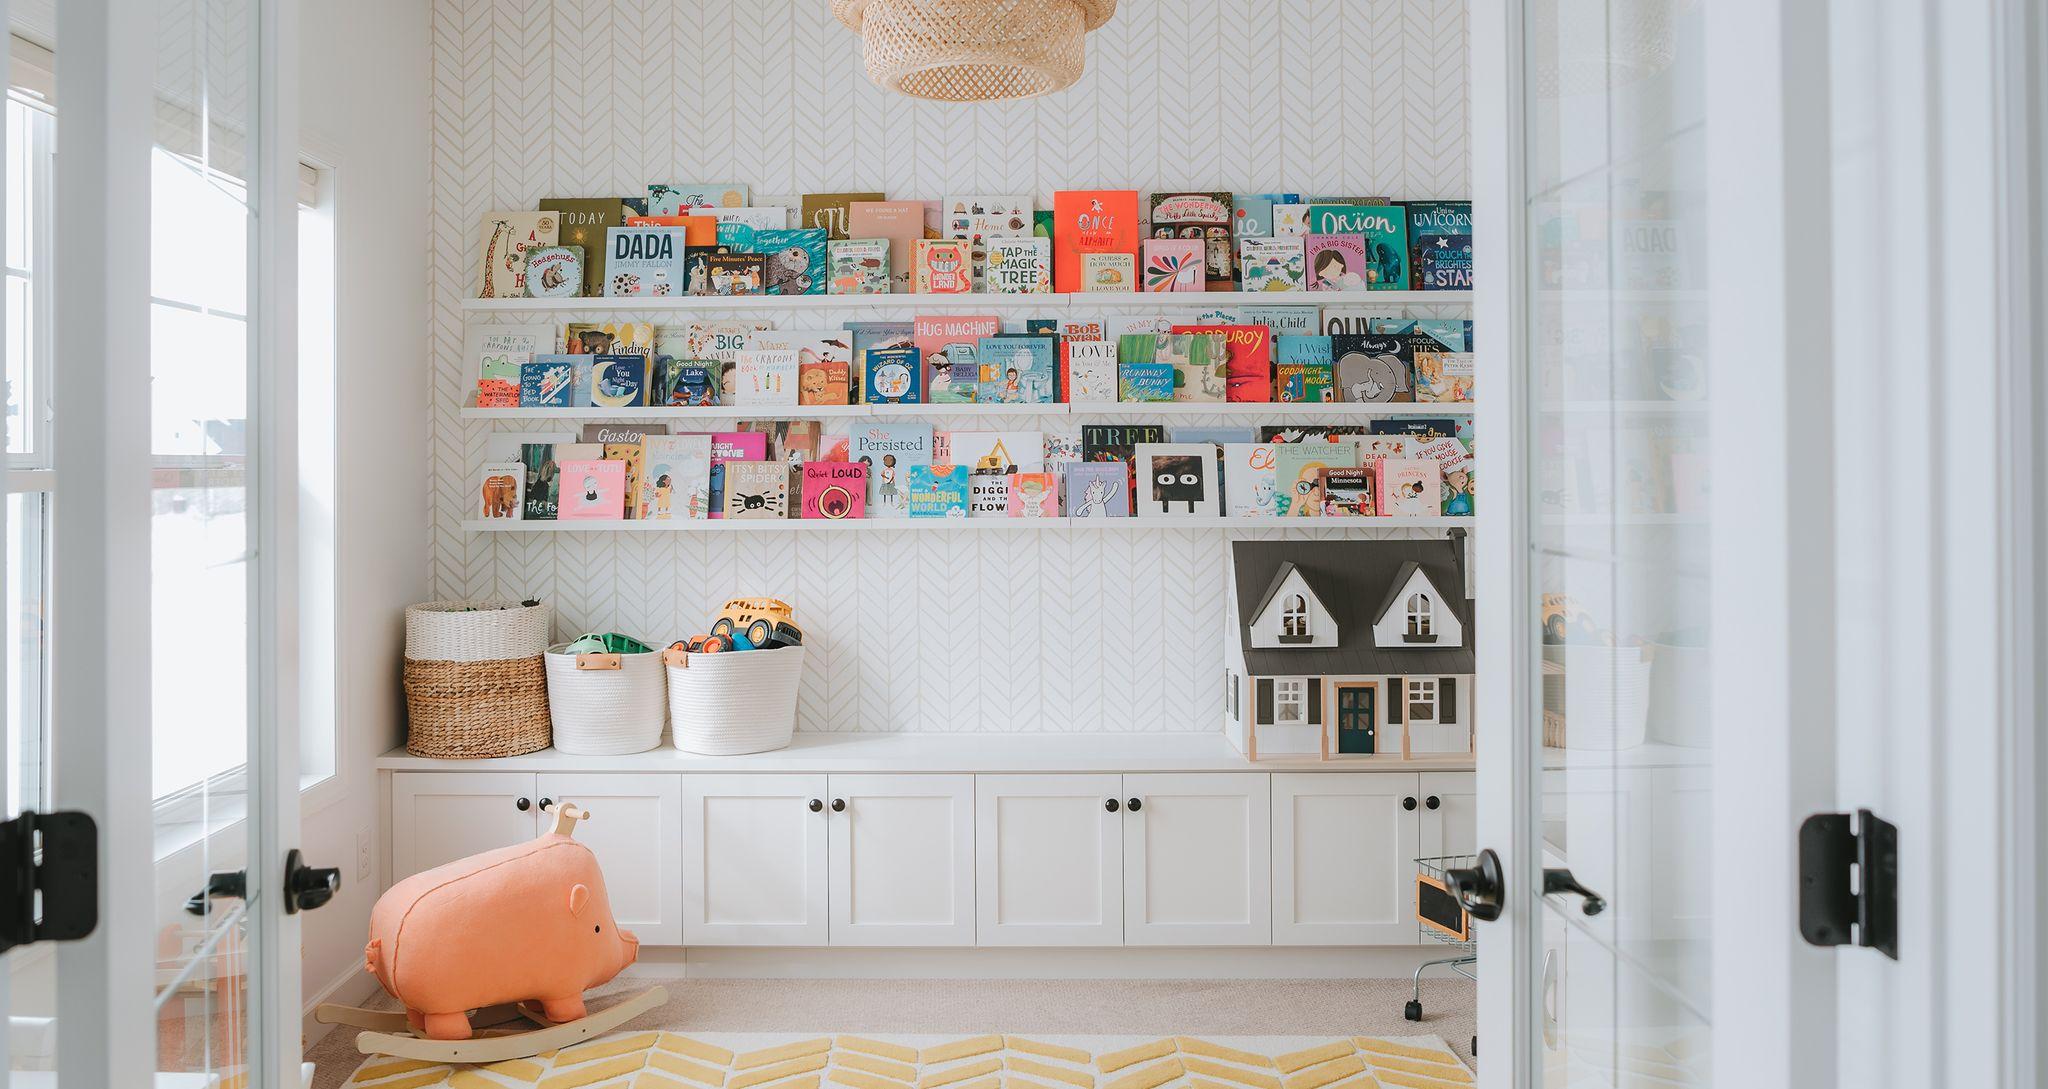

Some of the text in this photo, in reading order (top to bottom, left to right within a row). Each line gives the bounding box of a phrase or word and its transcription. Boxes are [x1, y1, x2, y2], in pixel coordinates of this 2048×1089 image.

[1160, 201, 1222, 214] THE WONDERFUL
[558, 212, 605, 225] TODAY
[974, 218, 1004, 231] Home
[1078, 213, 1114, 230] ONCE
[1413, 210, 1472, 227] UNICORN
[529, 230, 537, 241] A
[757, 236, 788, 246] Together
[615, 234, 673, 260] DADA
[1000, 247, 1022, 257] TAP
[1340, 240, 1364, 256] SISTER
[1434, 250, 1462, 259] TOUCH
[615, 260, 673, 269] JIMMY FALLON
[1000, 258, 1037, 269] MAGIC
[1000, 271, 1037, 284] TREE
[1436, 269, 1473, 287] STAR
[917, 321, 996, 336] HUG MACHINE
[1280, 316, 1306, 329] Child
[1327, 317, 1392, 335] OLIV
[715, 334, 744, 350] BIG
[1182, 329, 1264, 358] UROY
[1361, 340, 1387, 350] Always
[611, 341, 650, 358] Finding
[1072, 345, 1115, 358] LOVE
[694, 360, 713, 368] Night
[872, 359, 895, 372] WIZARD
[904, 362, 914, 371] OZ
[1313, 355, 1332, 364] Mo
[1121, 368, 1167, 377] RUNAWAY
[1279, 367, 1323, 375] GOODNIGHT
[1138, 378, 1171, 386] BUNNY
[869, 428, 890, 440] She
[1087, 428, 1158, 446] TREE
[859, 436, 923, 451] Persisted
[1423, 445, 1436, 456] YOU
[1436, 440, 1453, 452] GIVE
[1278, 446, 1351, 455] THE WATCHER
[1435, 448, 1458, 461] MOUSE
[731, 464, 787, 473] ITSY BITSY
[1439, 454, 1463, 470] COOKIE
[741, 474, 777, 483] SPIDER
[832, 467, 862, 478] LOUD
[1345, 469, 1363, 477] Night
[912, 491, 962, 502] WONDERFUL
[973, 486, 1008, 494] DIGG
[526, 499, 543, 514] The
[912, 503, 947, 511] WORLD
[972, 503, 1008, 511] FLOW
